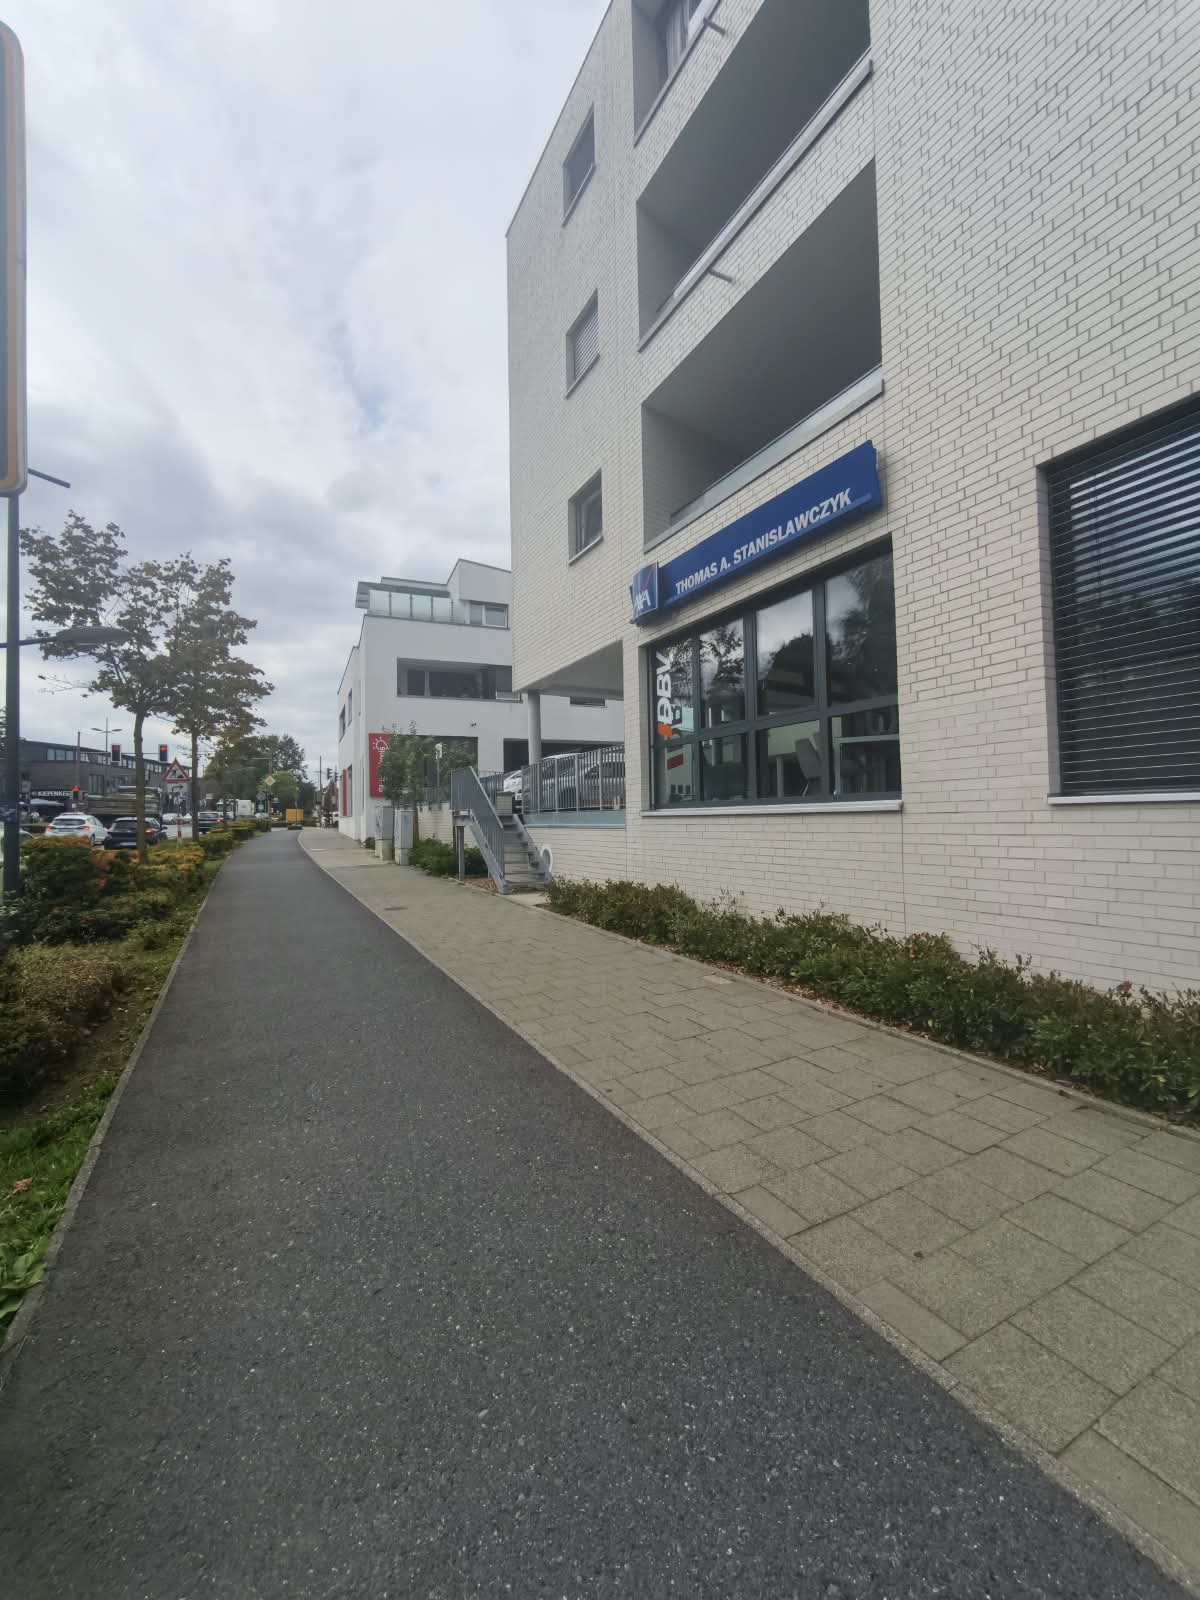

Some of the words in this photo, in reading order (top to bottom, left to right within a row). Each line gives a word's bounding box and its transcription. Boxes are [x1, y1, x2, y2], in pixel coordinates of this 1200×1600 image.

[675, 565, 718, 596] THOMAS
[719, 557, 732, 573] A.
[733, 487, 852, 564] STANISLAWCZYK
